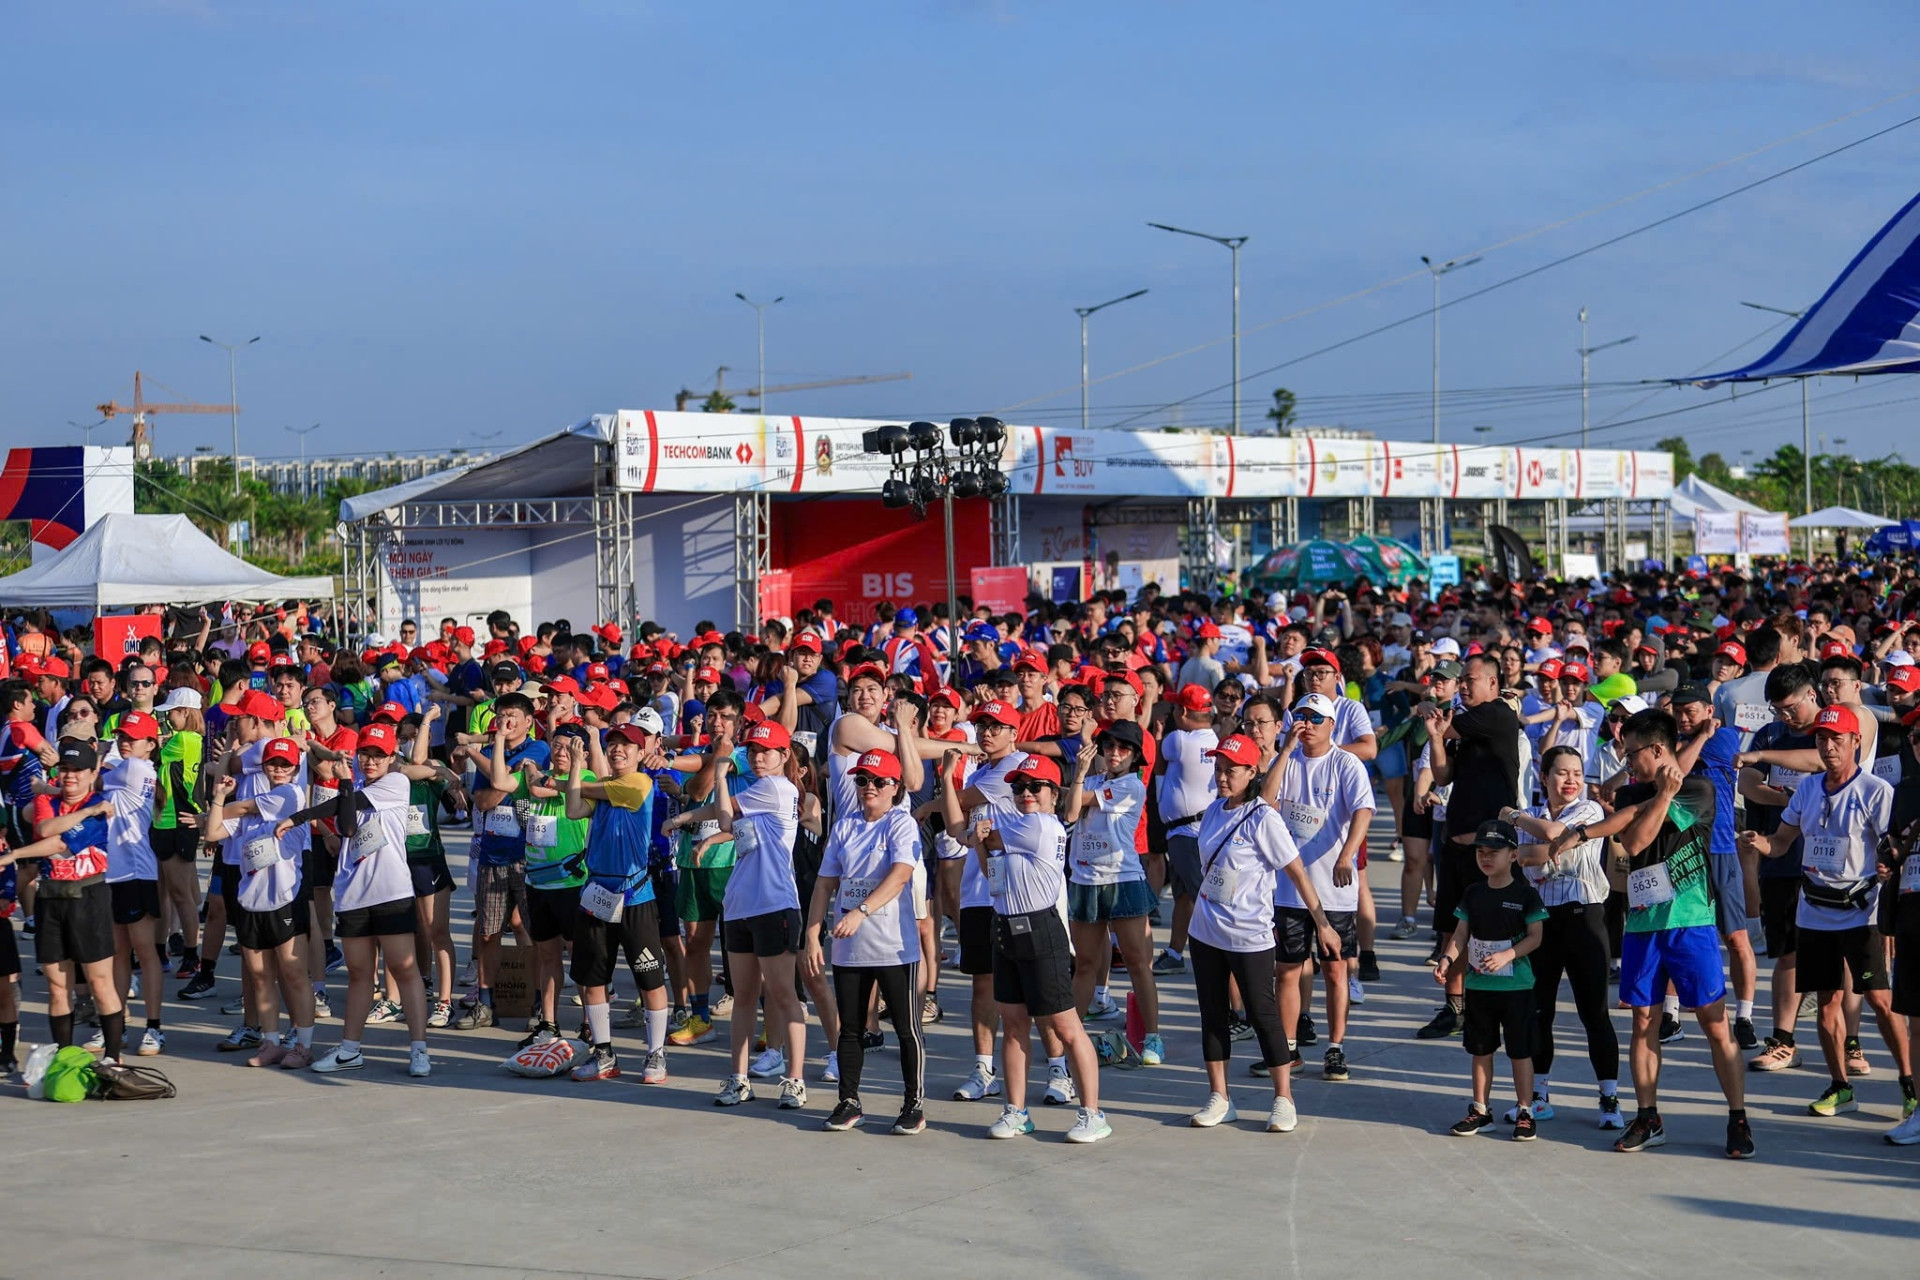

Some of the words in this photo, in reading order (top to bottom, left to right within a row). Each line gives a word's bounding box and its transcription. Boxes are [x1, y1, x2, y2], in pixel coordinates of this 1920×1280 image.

[663, 444, 733, 460] TECHCOMBANK
[1073, 460, 1094, 477] BUV
[862, 572, 914, 598] BIS
[124, 638, 141, 653] OMO
[1744, 711, 1766, 721] 6514
[491, 814, 512, 823] 6999
[1289, 811, 1312, 825] 5520
[354, 831, 373, 850] 6266
[1082, 841, 1102, 850] 5519
[247, 844, 264, 860] 6267
[1813, 846, 1835, 857] 0118
[1633, 877, 1659, 893] 5635
[592, 894, 612, 909] 1398
[633, 959, 660, 971] adidas
